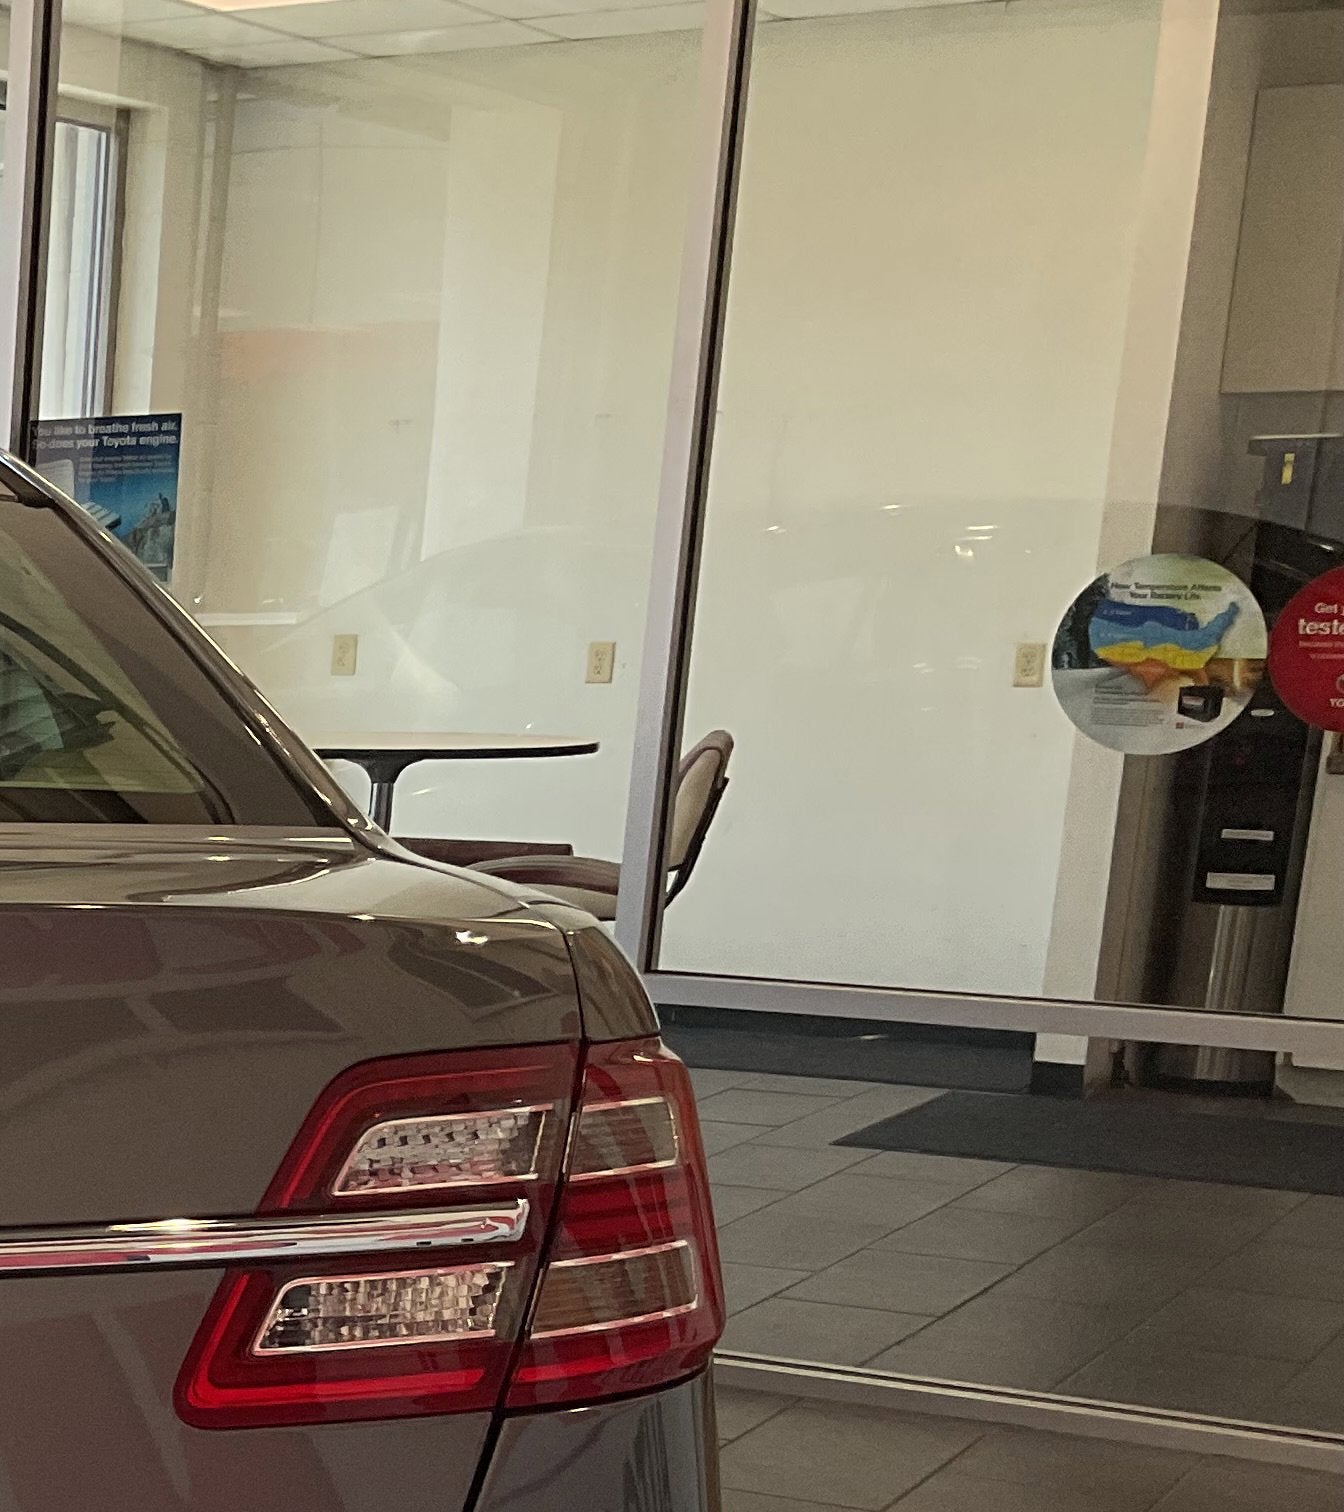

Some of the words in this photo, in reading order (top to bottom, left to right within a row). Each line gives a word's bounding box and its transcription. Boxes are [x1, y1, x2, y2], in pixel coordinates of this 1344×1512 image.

[75, 425, 86, 434] to
[88, 423, 129, 434] breathe
[132, 421, 158, 432] fresh
[77, 437, 99, 449] your
[103, 435, 137, 448] Toyota
[1314, 602, 1338, 613] Get
